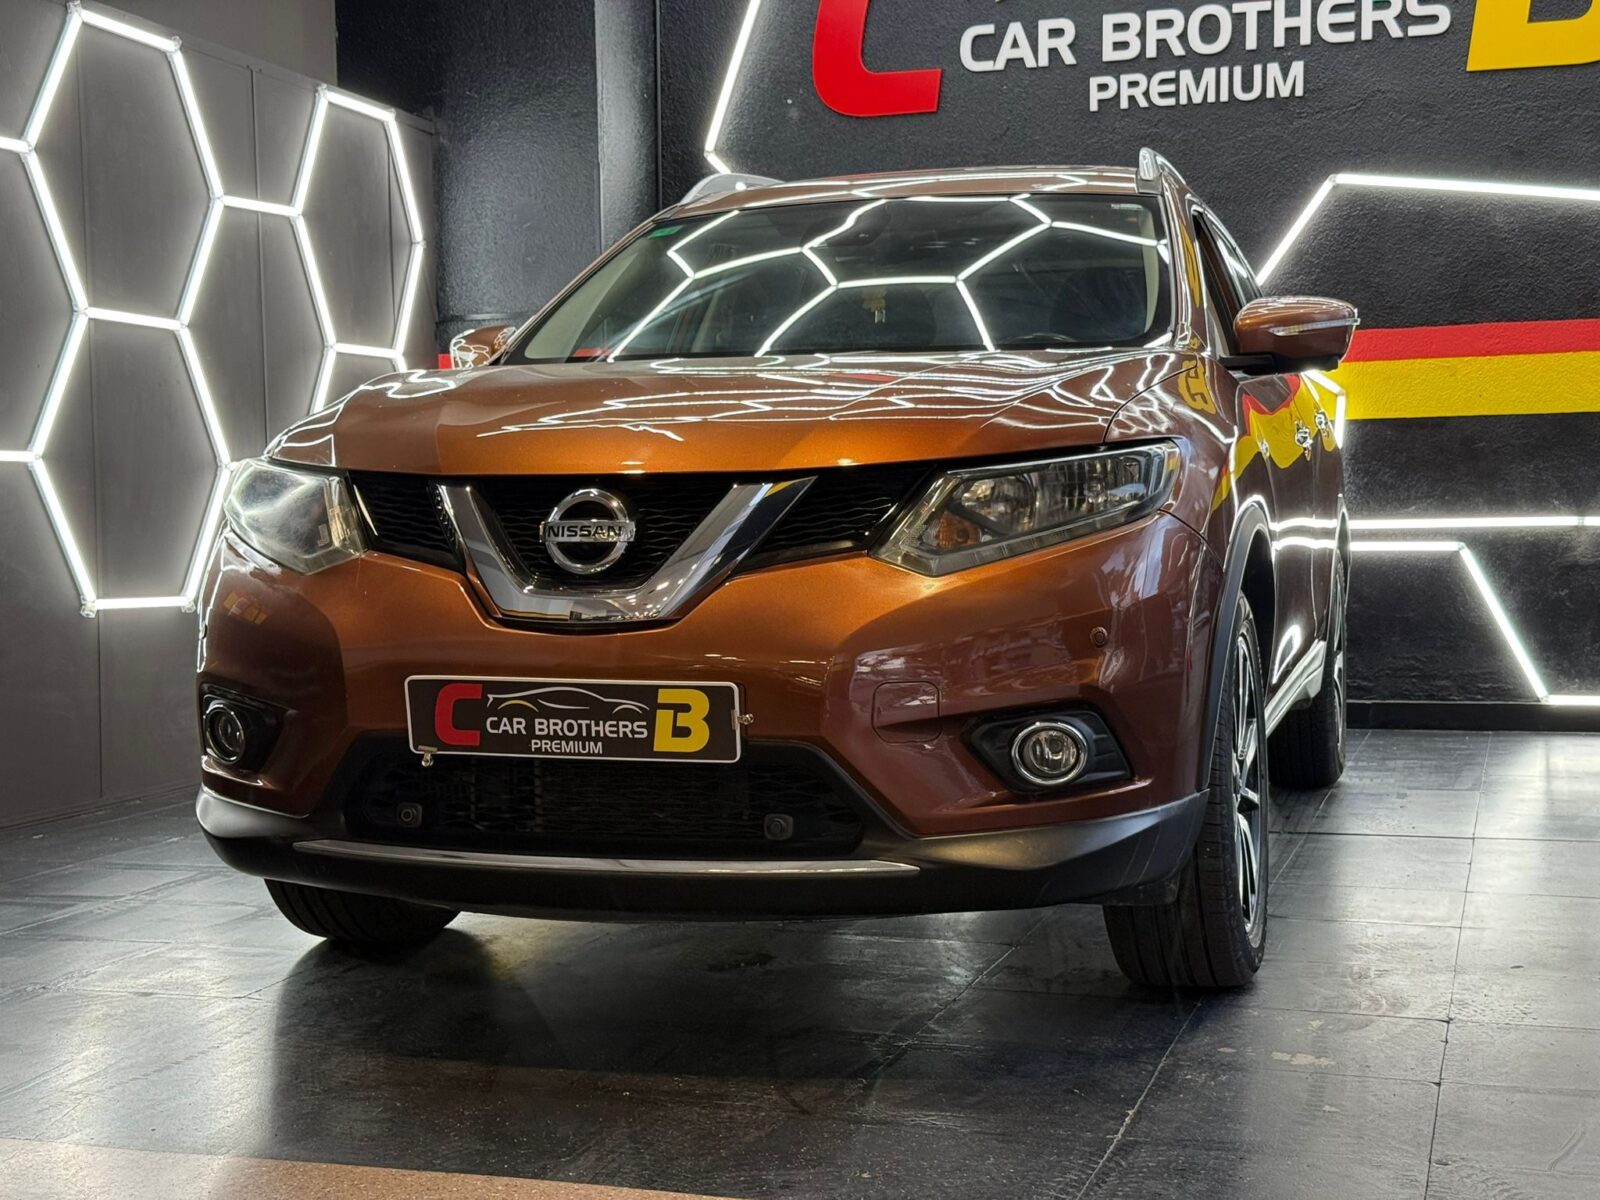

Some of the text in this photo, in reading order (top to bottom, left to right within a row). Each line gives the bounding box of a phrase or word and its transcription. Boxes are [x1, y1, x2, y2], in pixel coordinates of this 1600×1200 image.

[959, 18, 1078, 72] CAR
[1101, 0, 1452, 62] BROTHERS
[1089, 61, 1305, 112] PREMIUM
[548, 525, 622, 538] NISSAN
[435, 683, 483, 746] C
[486, 717, 648, 738] CAR BROTHERS
[653, 688, 710, 753] B
[530, 740, 603, 754] PREMIUM
